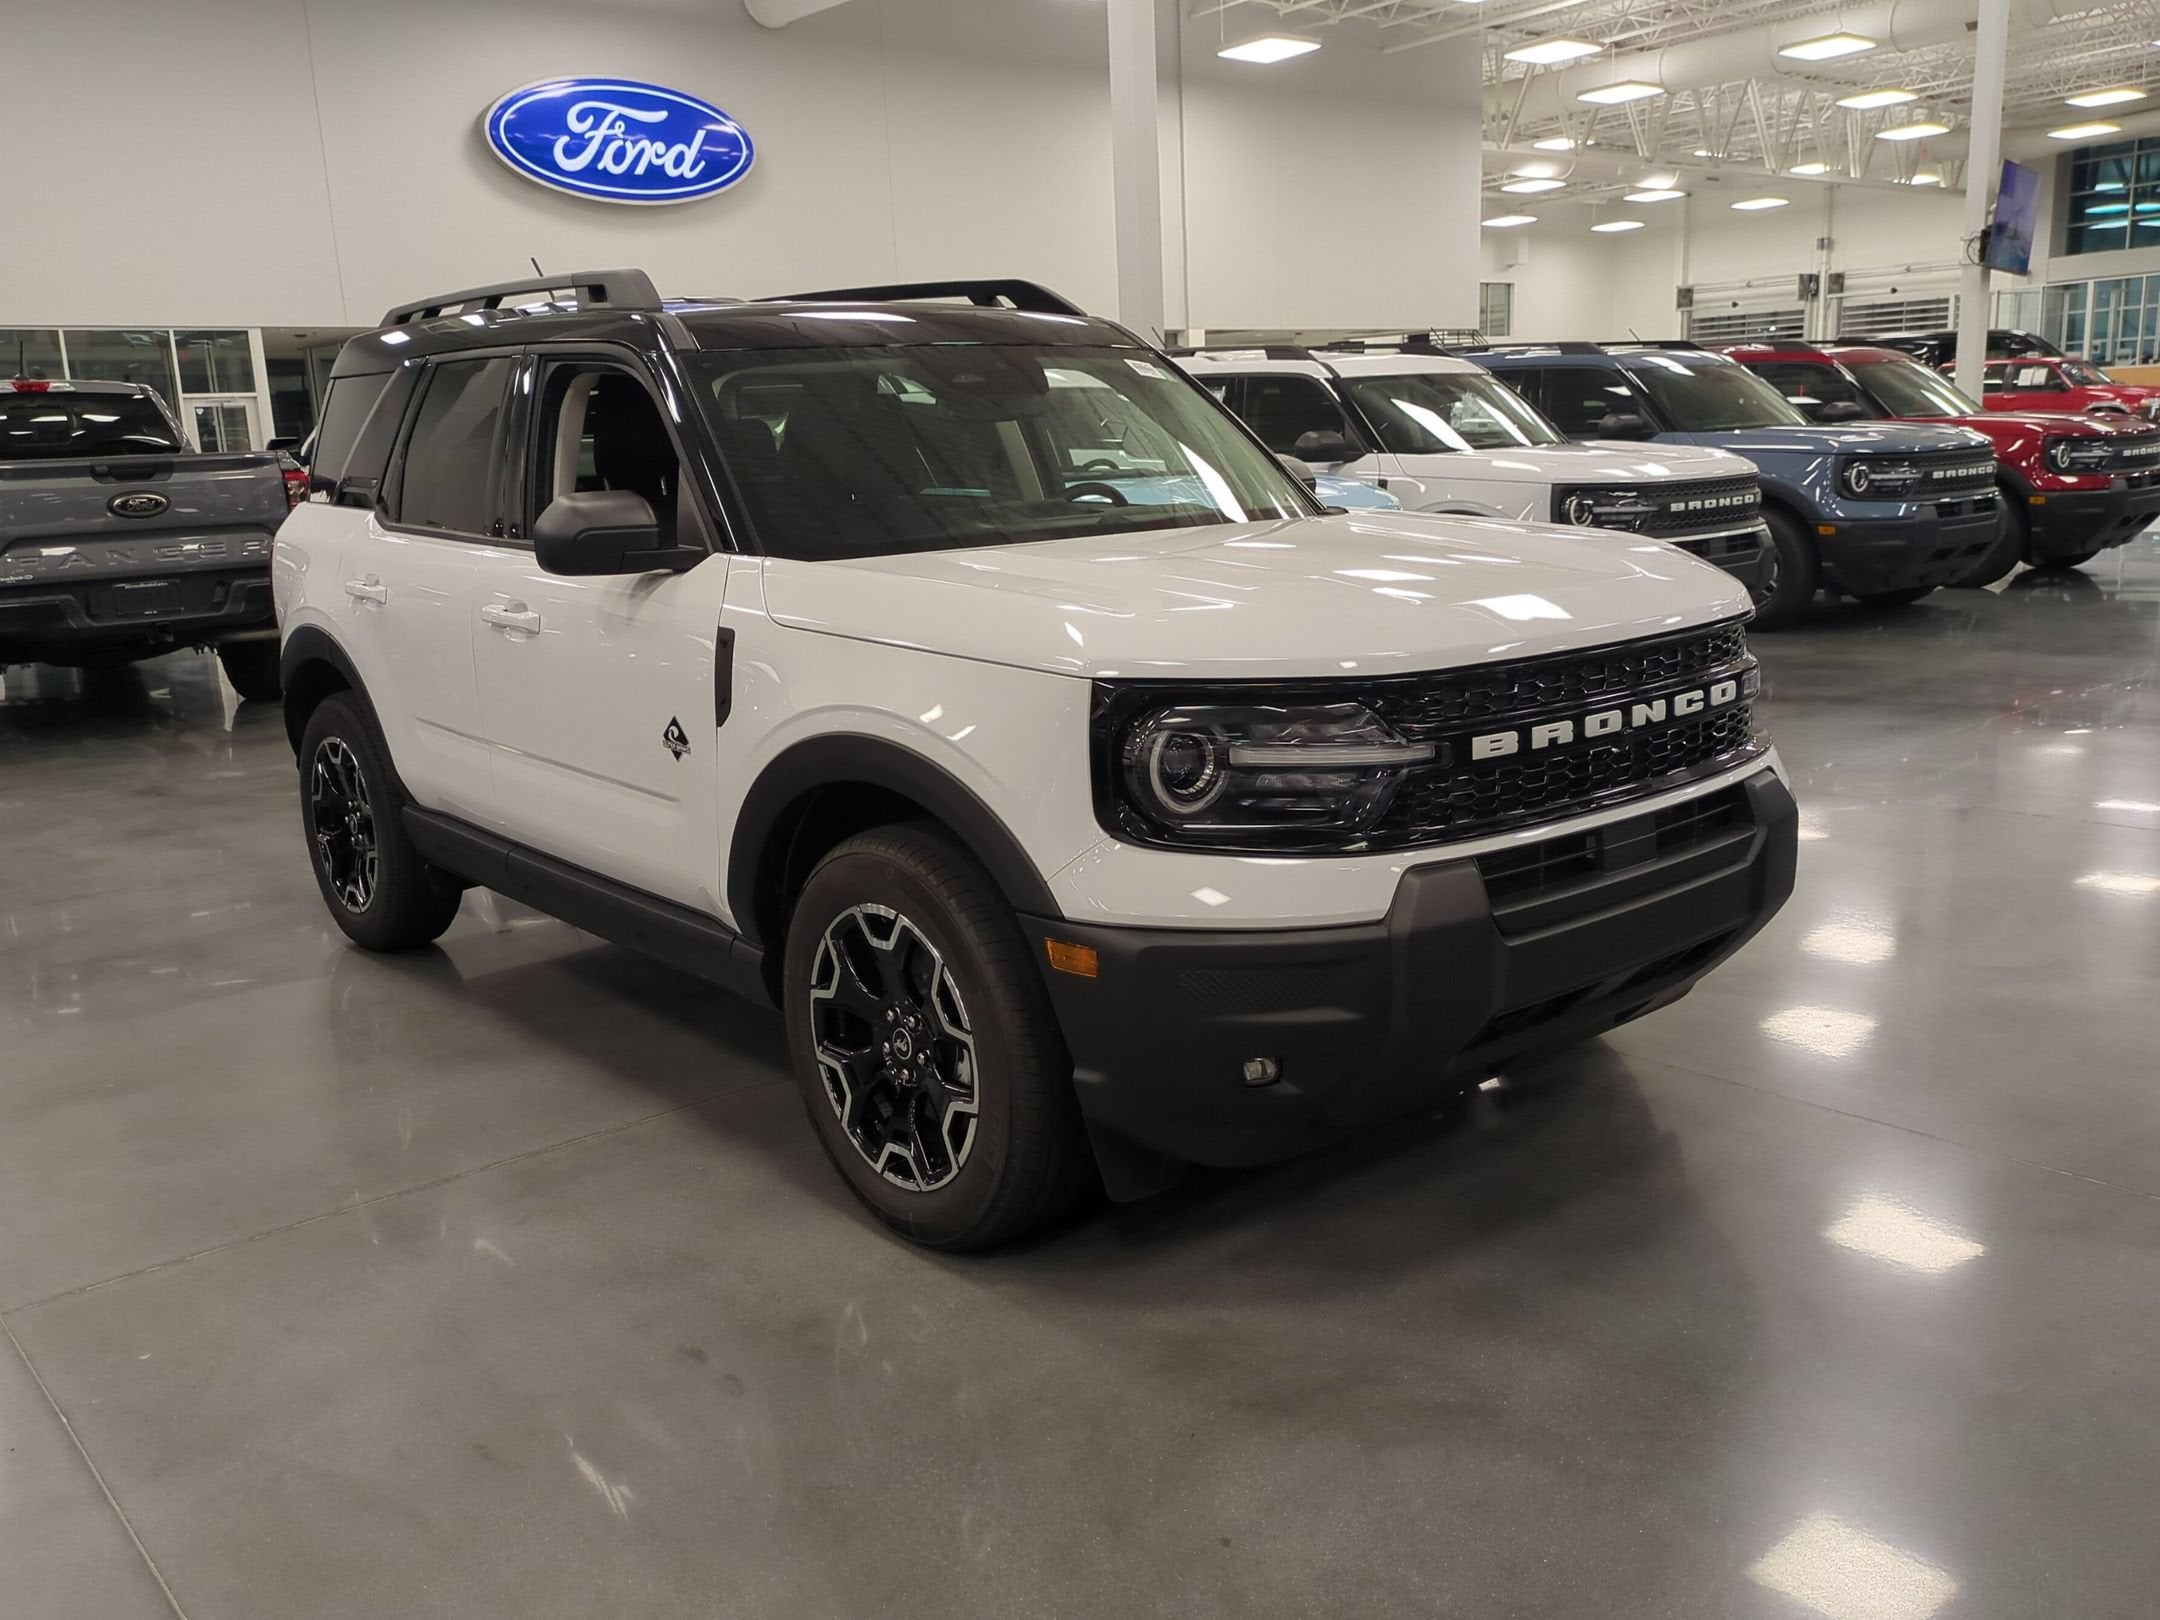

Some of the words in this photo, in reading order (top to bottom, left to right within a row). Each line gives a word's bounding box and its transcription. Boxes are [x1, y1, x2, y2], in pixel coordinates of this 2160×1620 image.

[553, 100, 706, 179] Ford
[1932, 465, 1993, 479] BRONCO
[1670, 494, 1755, 512] BRONCO
[1472, 680, 1736, 761] BRONCO
